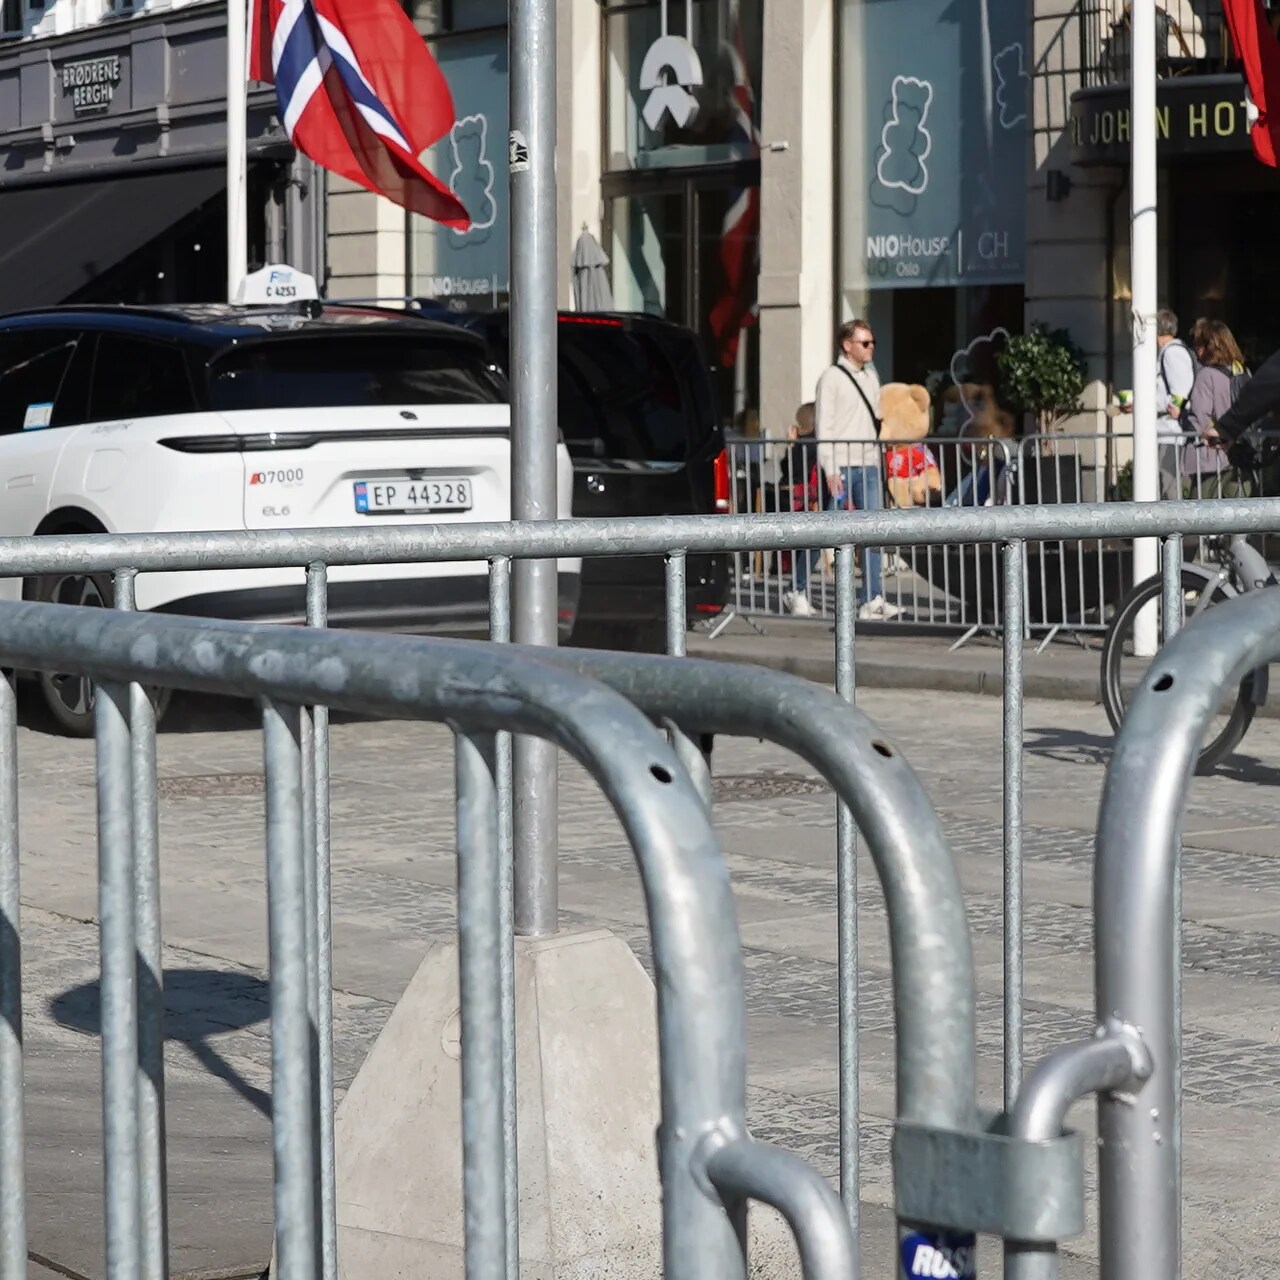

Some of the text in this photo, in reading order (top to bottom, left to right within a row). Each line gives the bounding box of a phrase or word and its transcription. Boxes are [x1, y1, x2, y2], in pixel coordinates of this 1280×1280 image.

[63, 61, 120, 88] BRØDRENE
[1090, 105, 1169, 144] JOHN
[977, 232, 1009, 260] CH
[258, 468, 304, 485] 07000
[374, 483, 468, 506] EP 44328
